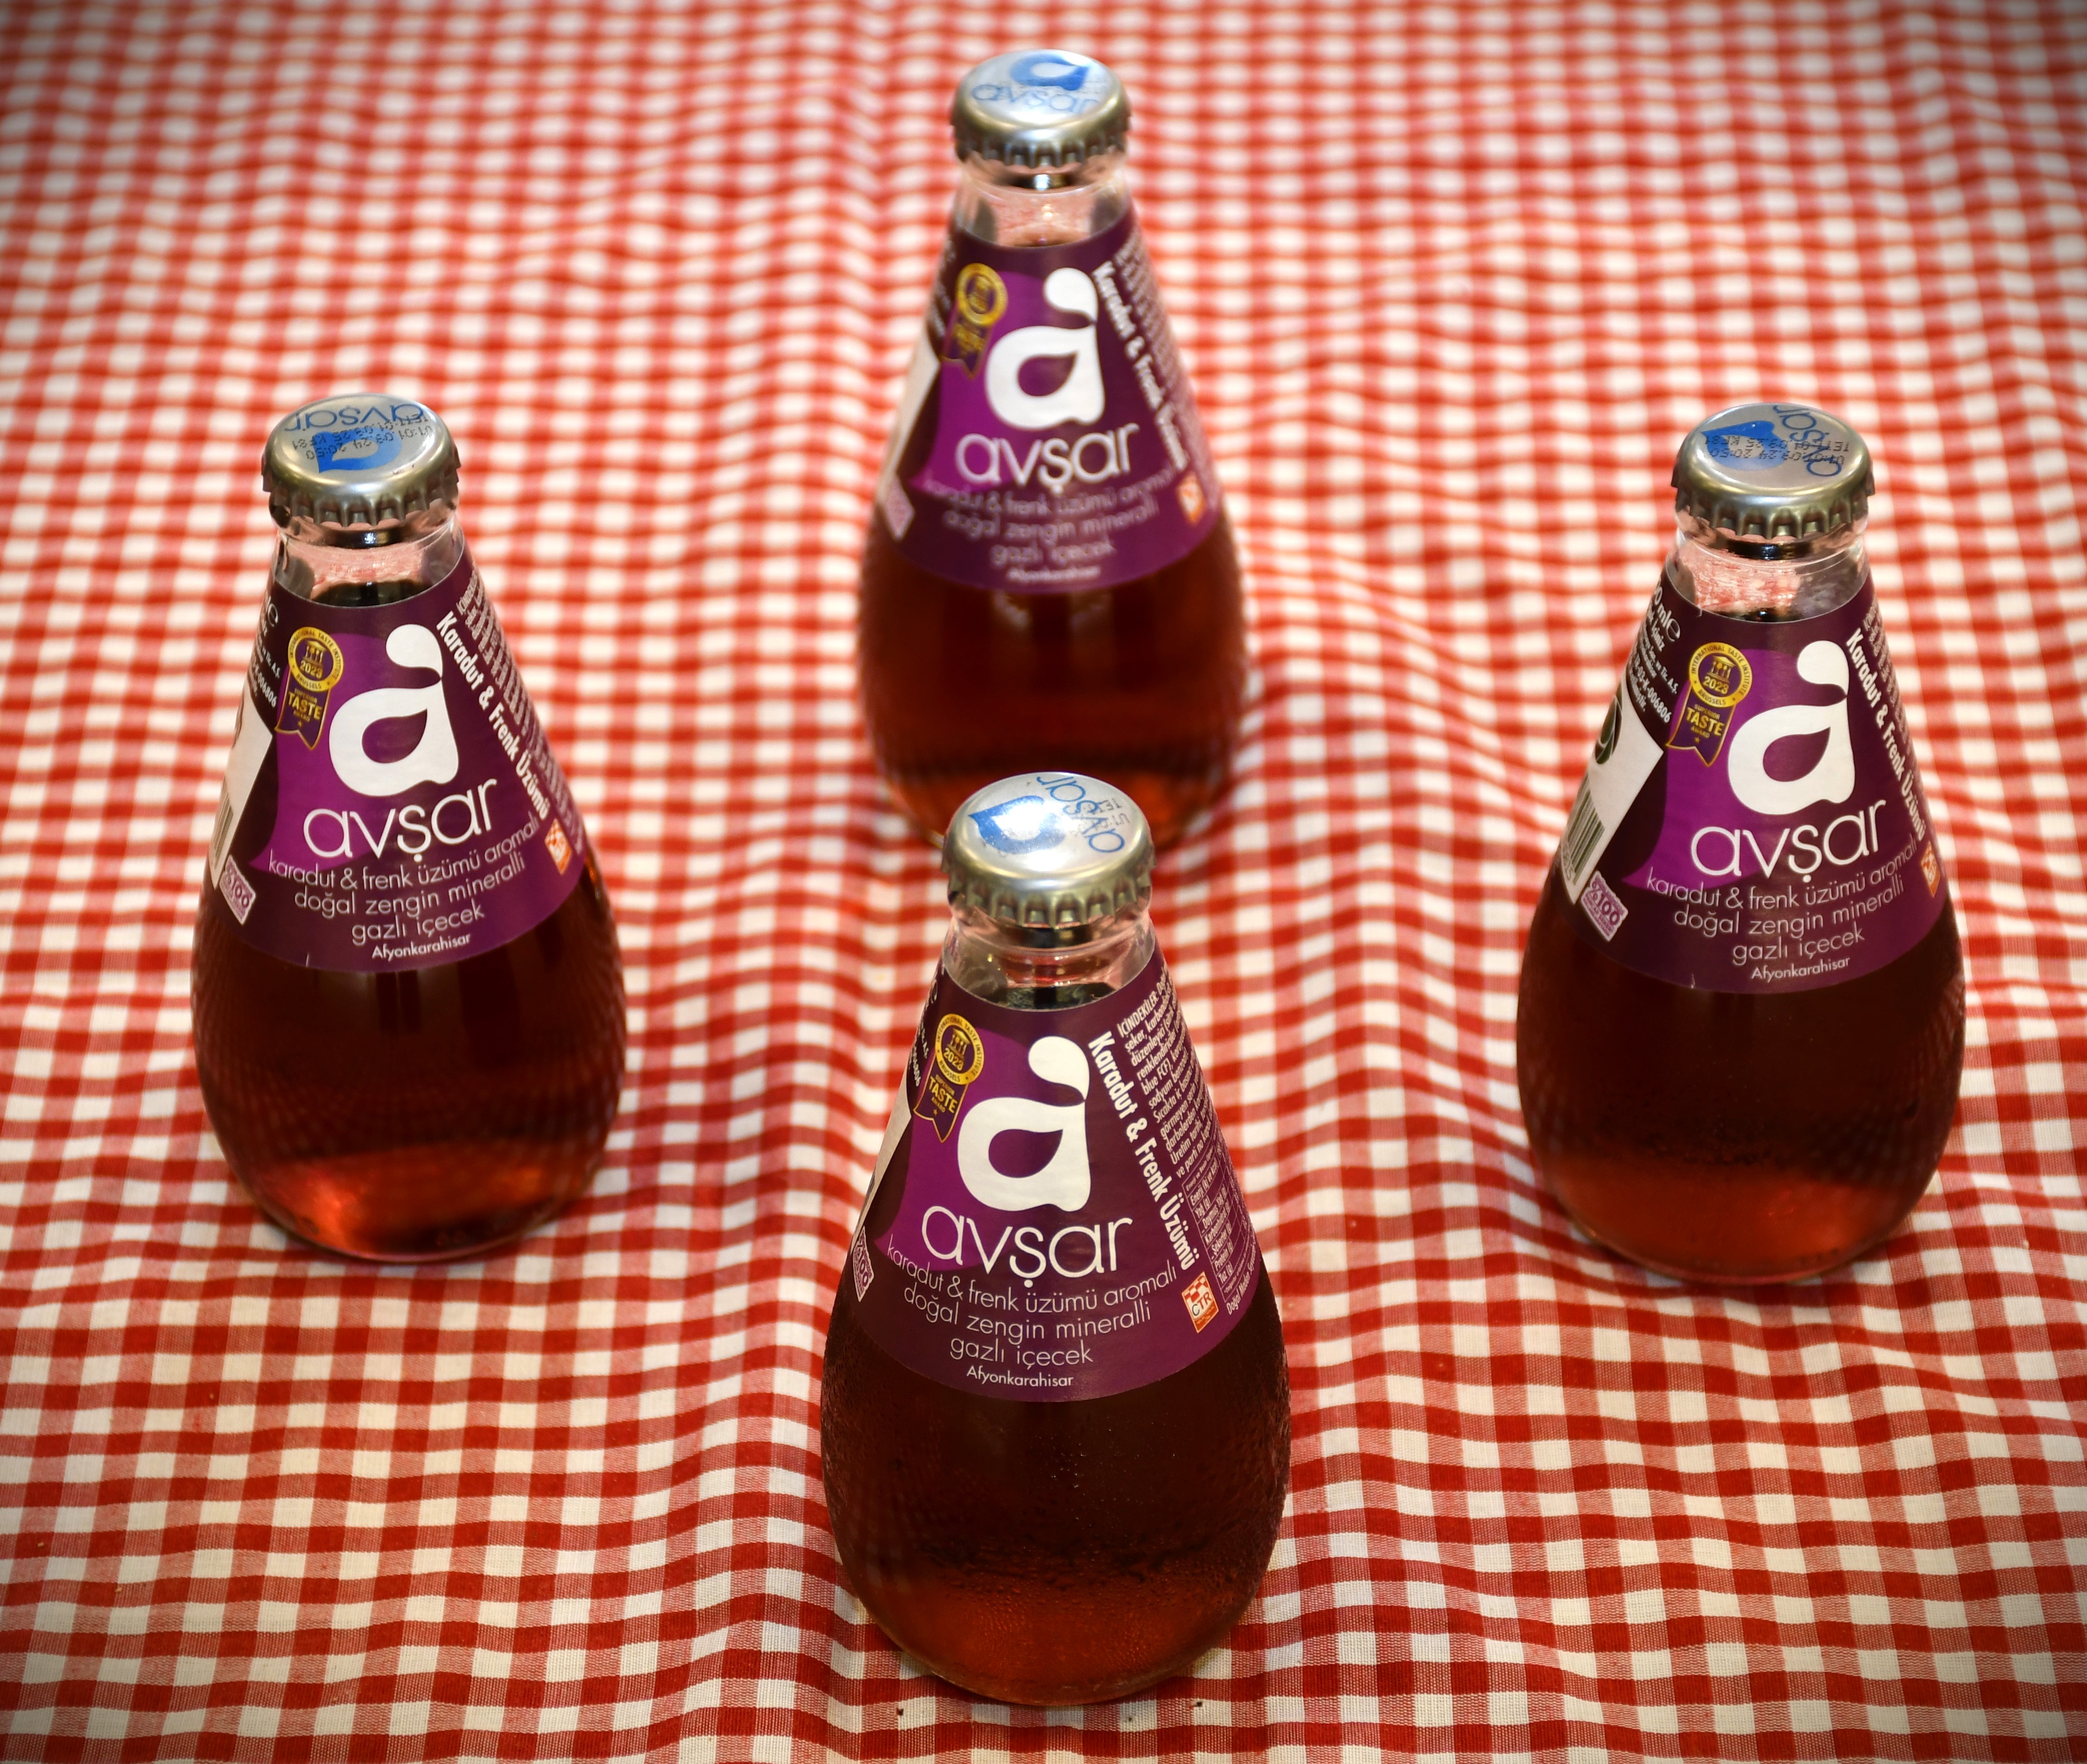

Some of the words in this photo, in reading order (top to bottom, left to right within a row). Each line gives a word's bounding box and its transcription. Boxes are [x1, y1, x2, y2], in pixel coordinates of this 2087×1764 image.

[955, 423, 1140, 495] avşar
[1691, 645, 1725, 674] INTERNATIONAL
[1728, 648, 1744, 663] TASTE
[1738, 661, 1751, 695] INSTITUTE
[288, 691, 322, 720] TASTE
[436, 611, 483, 690] Karadut
[478, 686, 494, 711] &
[488, 702, 520, 761] Frenk
[515, 750, 550, 819] Üzümü
[1694, 704, 1720, 720] SUPERIOR
[1698, 689, 1726, 706] BRUSSELS
[1686, 707, 1724, 736] TASTE
[1691, 726, 1710, 738] AWARD
[1847, 628, 1882, 707] Karadut
[1876, 705, 1888, 728] &
[1883, 723, 1904, 781] Frenk
[1902, 770, 1927, 841] Üzümü
[303, 778, 497, 862] avşar
[1690, 799, 1887, 883] avşar
[268, 850, 335, 889] karadut
[340, 868, 357, 889] &
[362, 866, 413, 890] frenk
[418, 853, 480, 885] üzümü
[484, 813, 540, 863] aromalı
[295, 888, 356, 919] doğal
[365, 888, 439, 917] zengin
[449, 851, 524, 900] mineralli
[1647, 868, 1721, 907] karadut
[1727, 889, 1744, 910] &
[1749, 886, 1800, 910] frenk
[1805, 872, 1865, 906] üzümü
[352, 916, 406, 946] gazlı
[417, 899, 484, 936] içecek
[1675, 909, 1740, 939] doğal
[1749, 908, 1824, 938] zengin
[1833, 874, 1903, 922] mineralli
[371, 933, 471, 960] Afyonkarahisar
[1732, 934, 1788, 966] gazlı
[1799, 927, 1864, 957] içecek
[1752, 956, 1851, 982] Afyonkarahisar
[929, 1075, 958, 1114] TASTE
[1088, 1031, 1137, 1124] Karadut
[1150, 1079, 1173, 1109] sodyum
[1154, 1095, 1176, 1123] Sıcakta
[1127, 1118, 1147, 1143] &
[1135, 1138, 1172, 1202] Frenk
[1177, 1165, 1185, 1178] ve
[922, 1206, 1133, 1288] avşar
[1160, 1194, 1199, 1271] Üzümü
[887, 1235, 945, 1293] karadut
[946, 1274, 964, 1300] &
[968, 1283, 1019, 1312] frenk
[1026, 1288, 1098, 1312] üzümü
[1104, 1265, 1178, 1307] aromalı
[904, 1283, 959, 1326] doğal
[967, 1314, 1045, 1345] zengin
[1057, 1300, 1151, 1340] mineralli
[1192, 1291, 1212, 1316] CTR
[950, 1337, 1005, 1364] gazlı
[1016, 1345, 1093, 1369] içecek
[966, 1365, 1074, 1387] Afyonkarahisar
